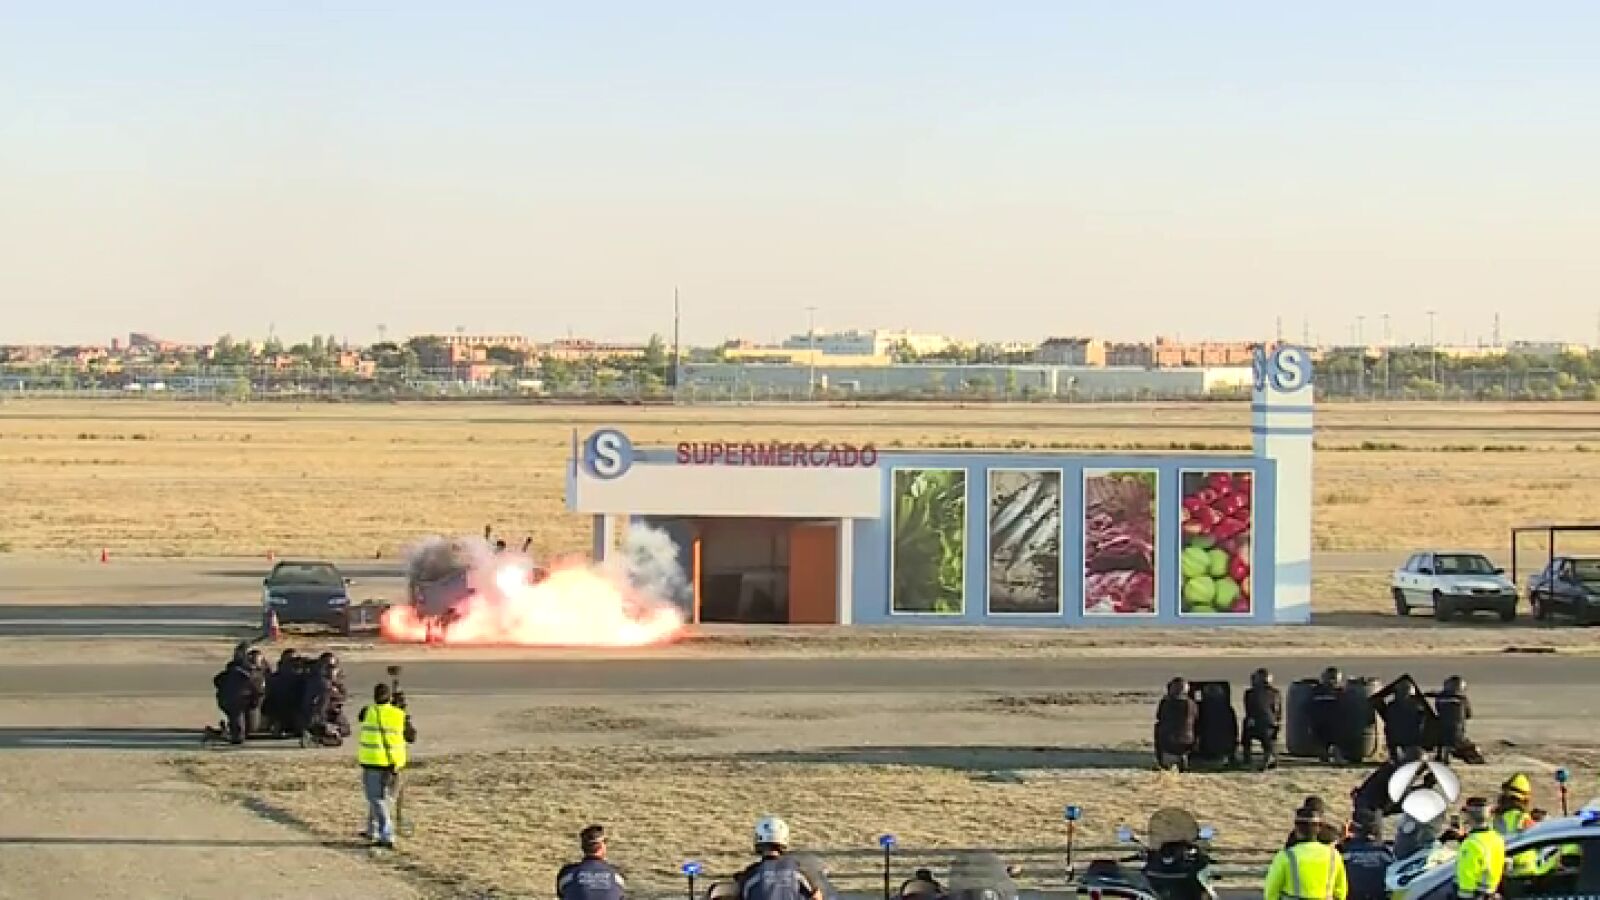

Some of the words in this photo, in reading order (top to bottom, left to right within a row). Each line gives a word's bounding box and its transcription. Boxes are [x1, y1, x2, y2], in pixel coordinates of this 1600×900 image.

[1277, 349, 1302, 388] S
[594, 432, 621, 475] S
[676, 441, 877, 467] SUPERMERCADO
